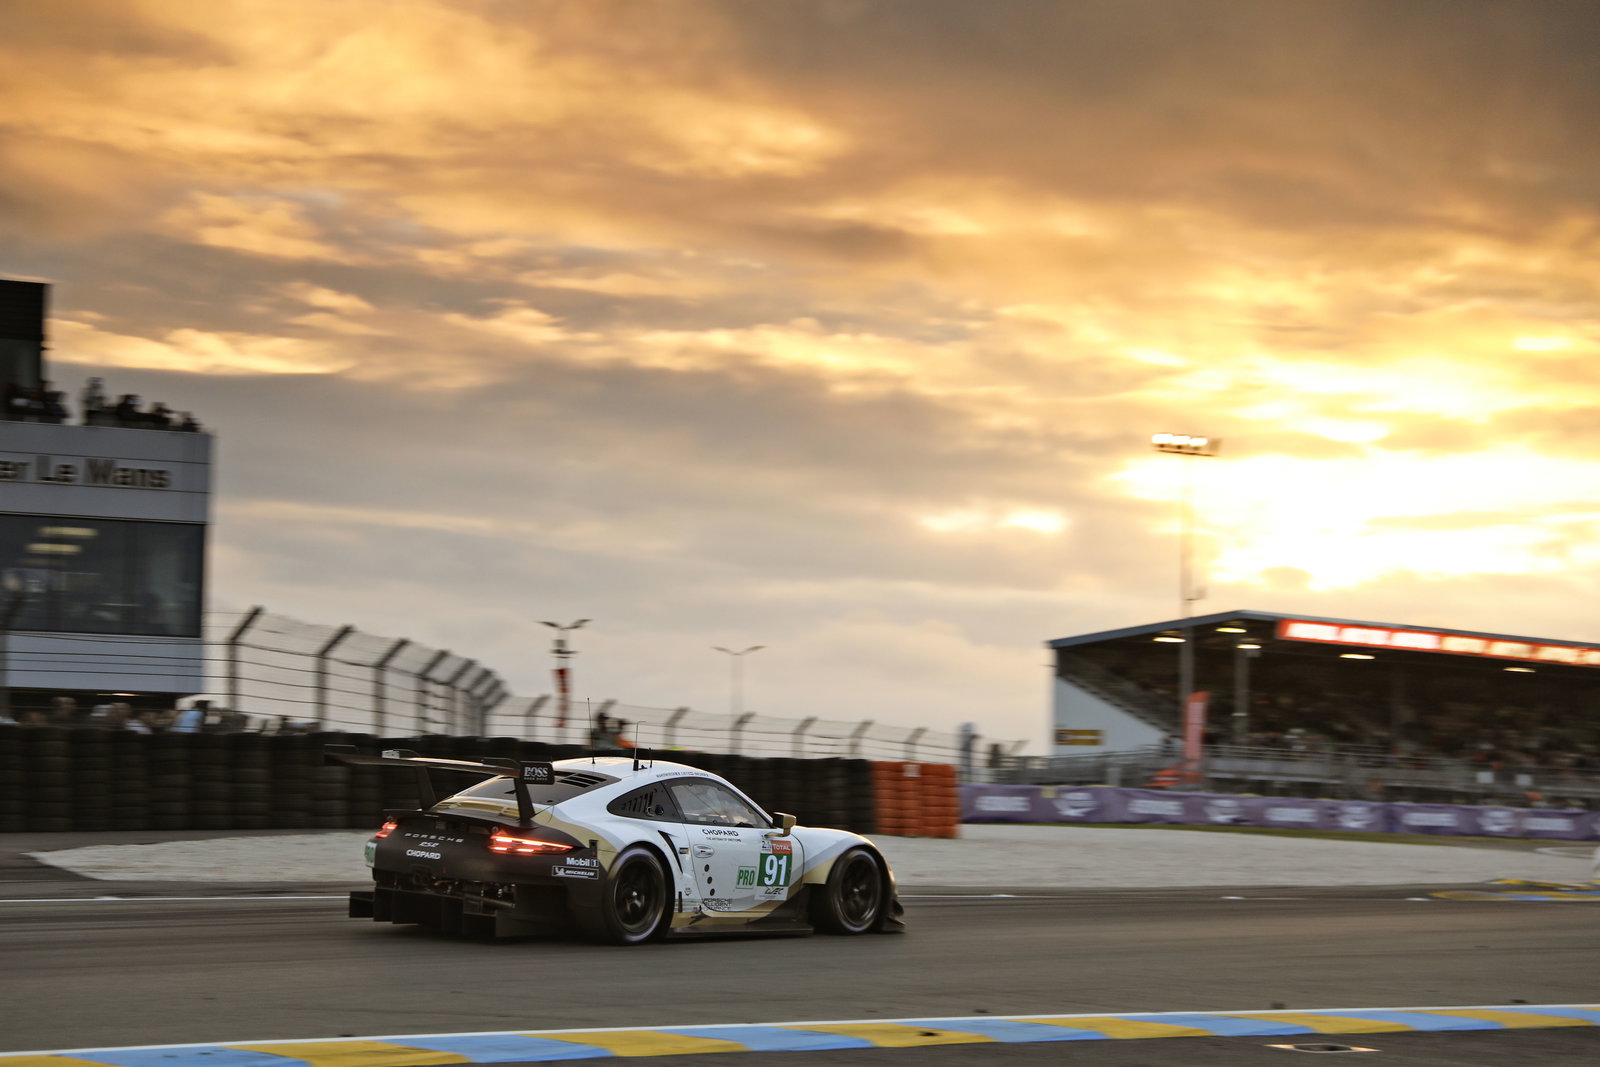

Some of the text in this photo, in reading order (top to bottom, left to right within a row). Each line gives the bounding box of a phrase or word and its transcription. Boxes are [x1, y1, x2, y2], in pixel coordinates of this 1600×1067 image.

[36, 455, 78, 483] Le
[524, 766, 548, 778] BOSS
[404, 833, 464, 843] PORSCHE
[702, 829, 739, 837] CHOPARD
[772, 843, 791, 851] TOTAL
[406, 849, 441, 860] CHOPARD
[566, 857, 590, 867] Mobil
[764, 854, 787, 886] 91
[737, 869, 755, 886] PRO
